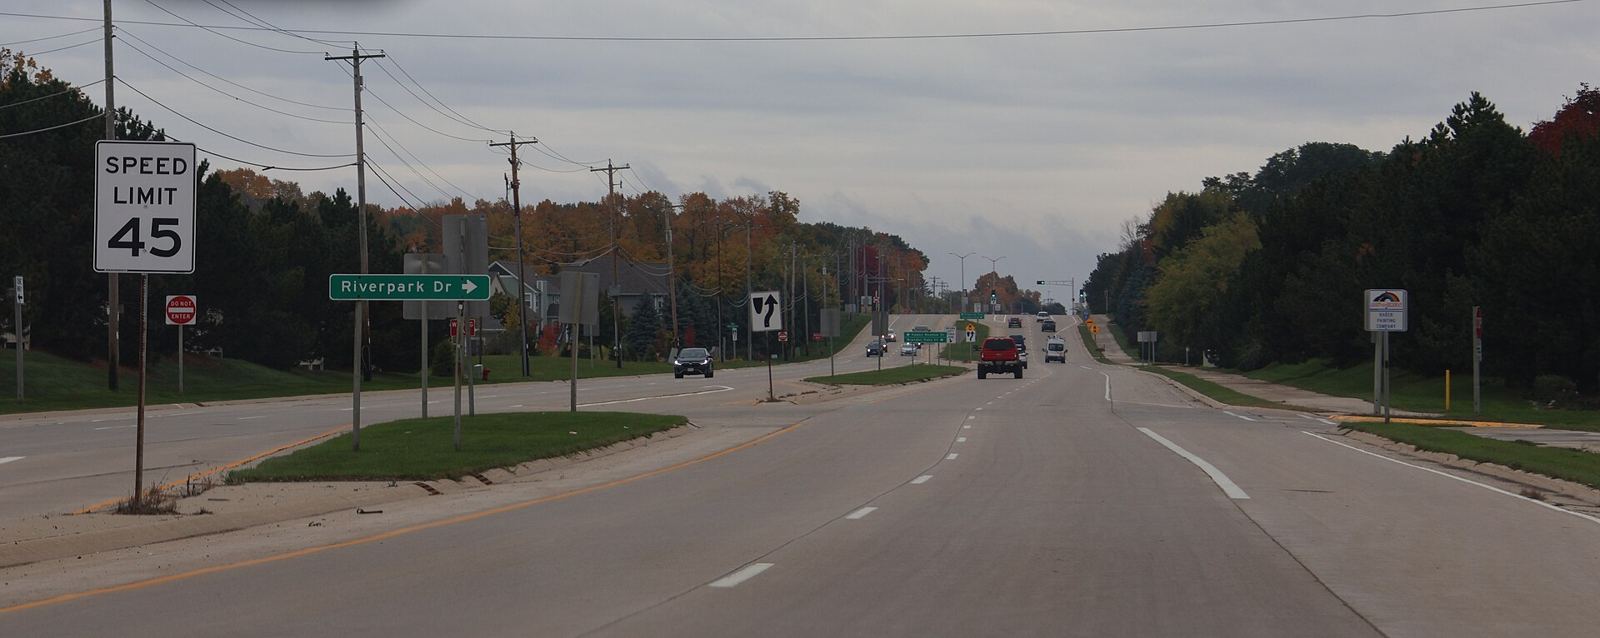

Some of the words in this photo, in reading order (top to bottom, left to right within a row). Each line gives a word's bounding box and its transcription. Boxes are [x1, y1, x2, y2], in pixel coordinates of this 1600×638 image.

[105, 156, 188, 175] SPEED
[113, 186, 178, 205] LIMIT
[107, 217, 182, 258] 45
[341, 280, 425, 295] Riverpark
[433, 280, 452, 293] Dr
